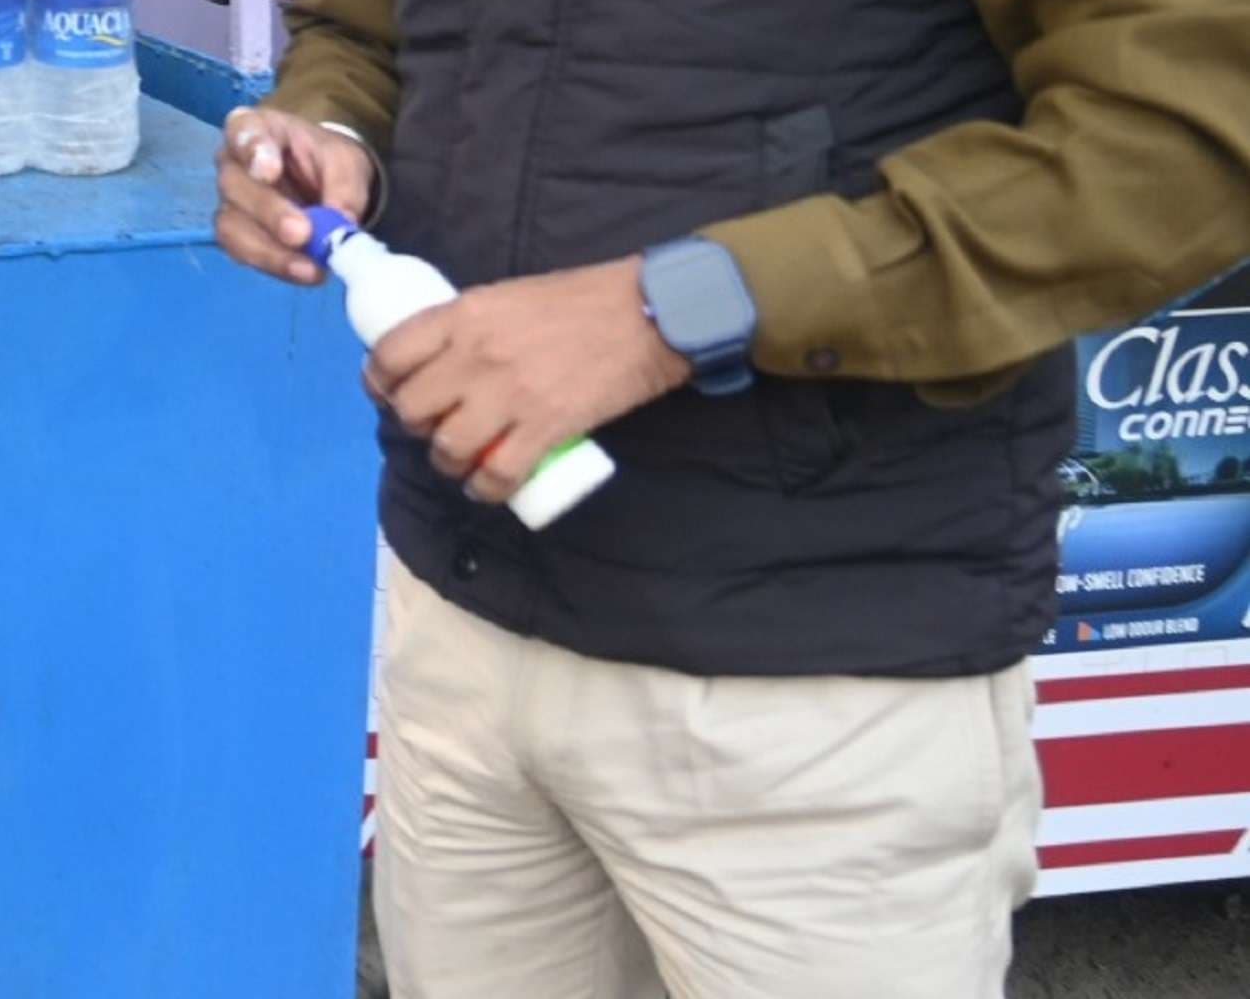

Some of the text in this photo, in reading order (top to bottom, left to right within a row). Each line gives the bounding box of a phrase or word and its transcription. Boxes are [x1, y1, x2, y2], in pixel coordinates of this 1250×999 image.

[1086, 326, 1250, 410] Clas
[1126, 564, 1206, 588] CONFIDENCE
[1165, 617, 1198, 634] BLEND
